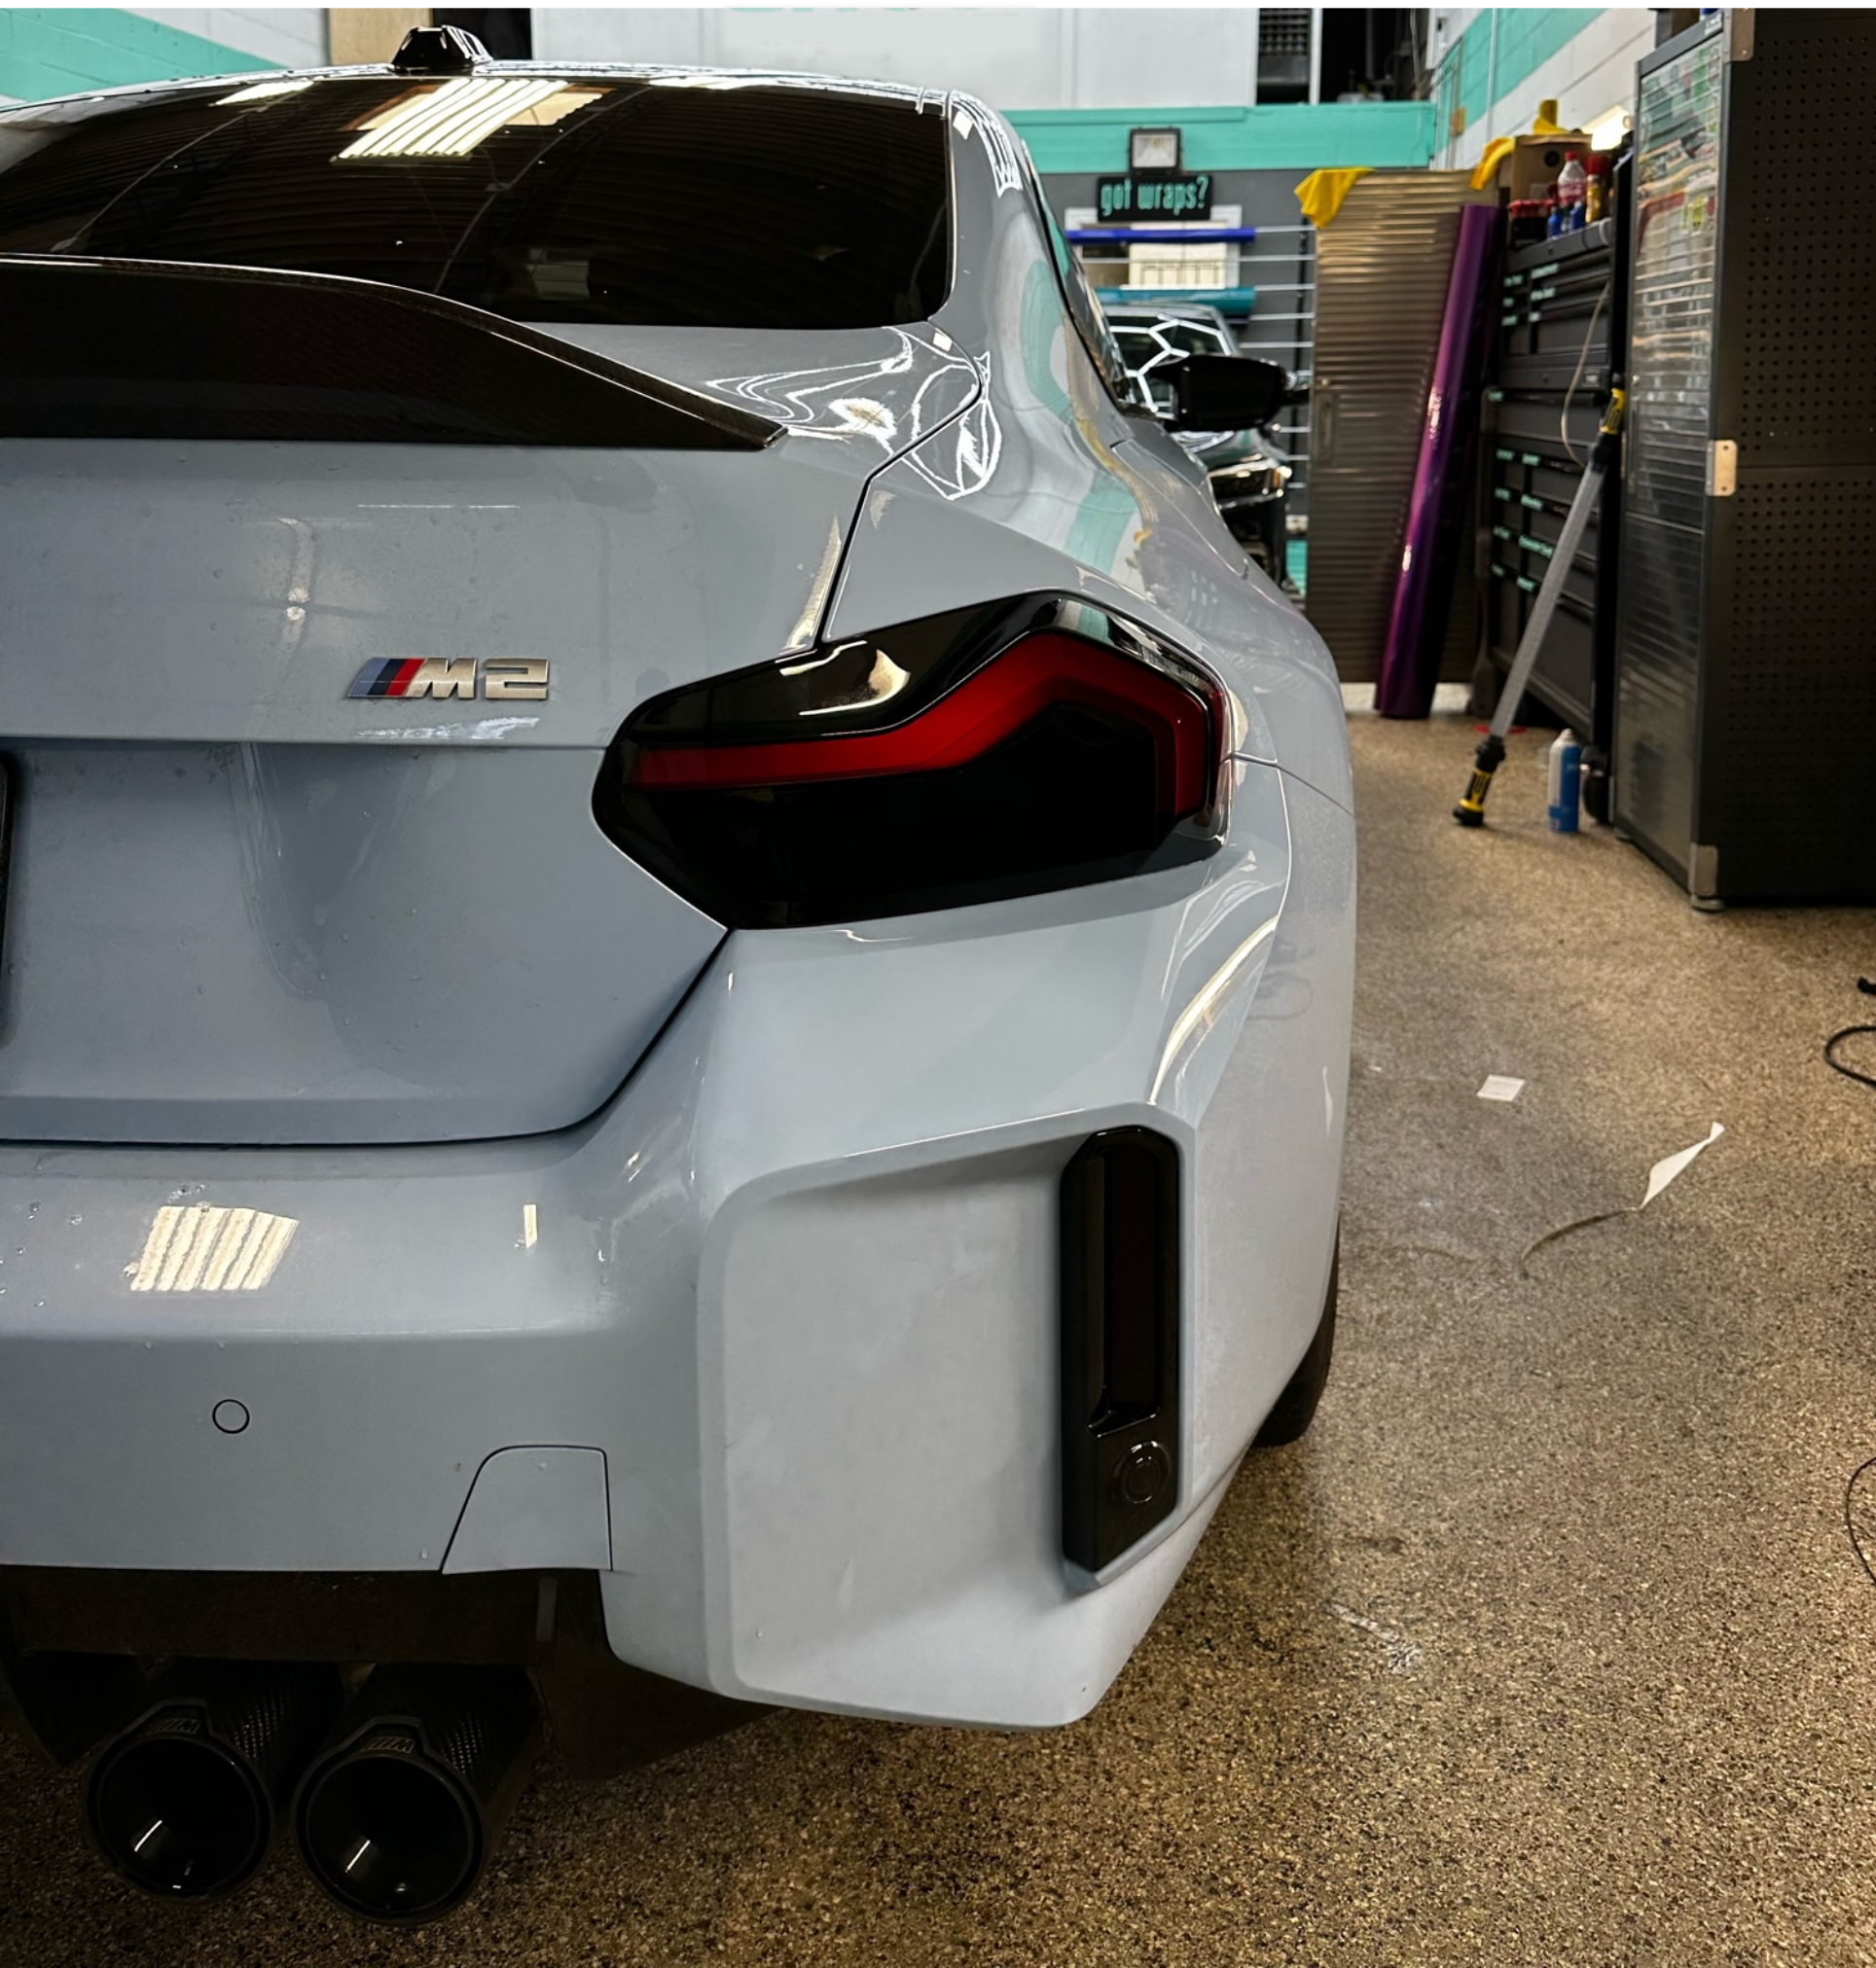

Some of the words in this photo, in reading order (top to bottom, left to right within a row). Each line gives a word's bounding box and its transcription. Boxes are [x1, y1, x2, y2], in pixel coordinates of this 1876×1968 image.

[1100, 177, 1132, 216] got
[1137, 174, 1209, 216] wraps?
[402, 658, 550, 700] M2
